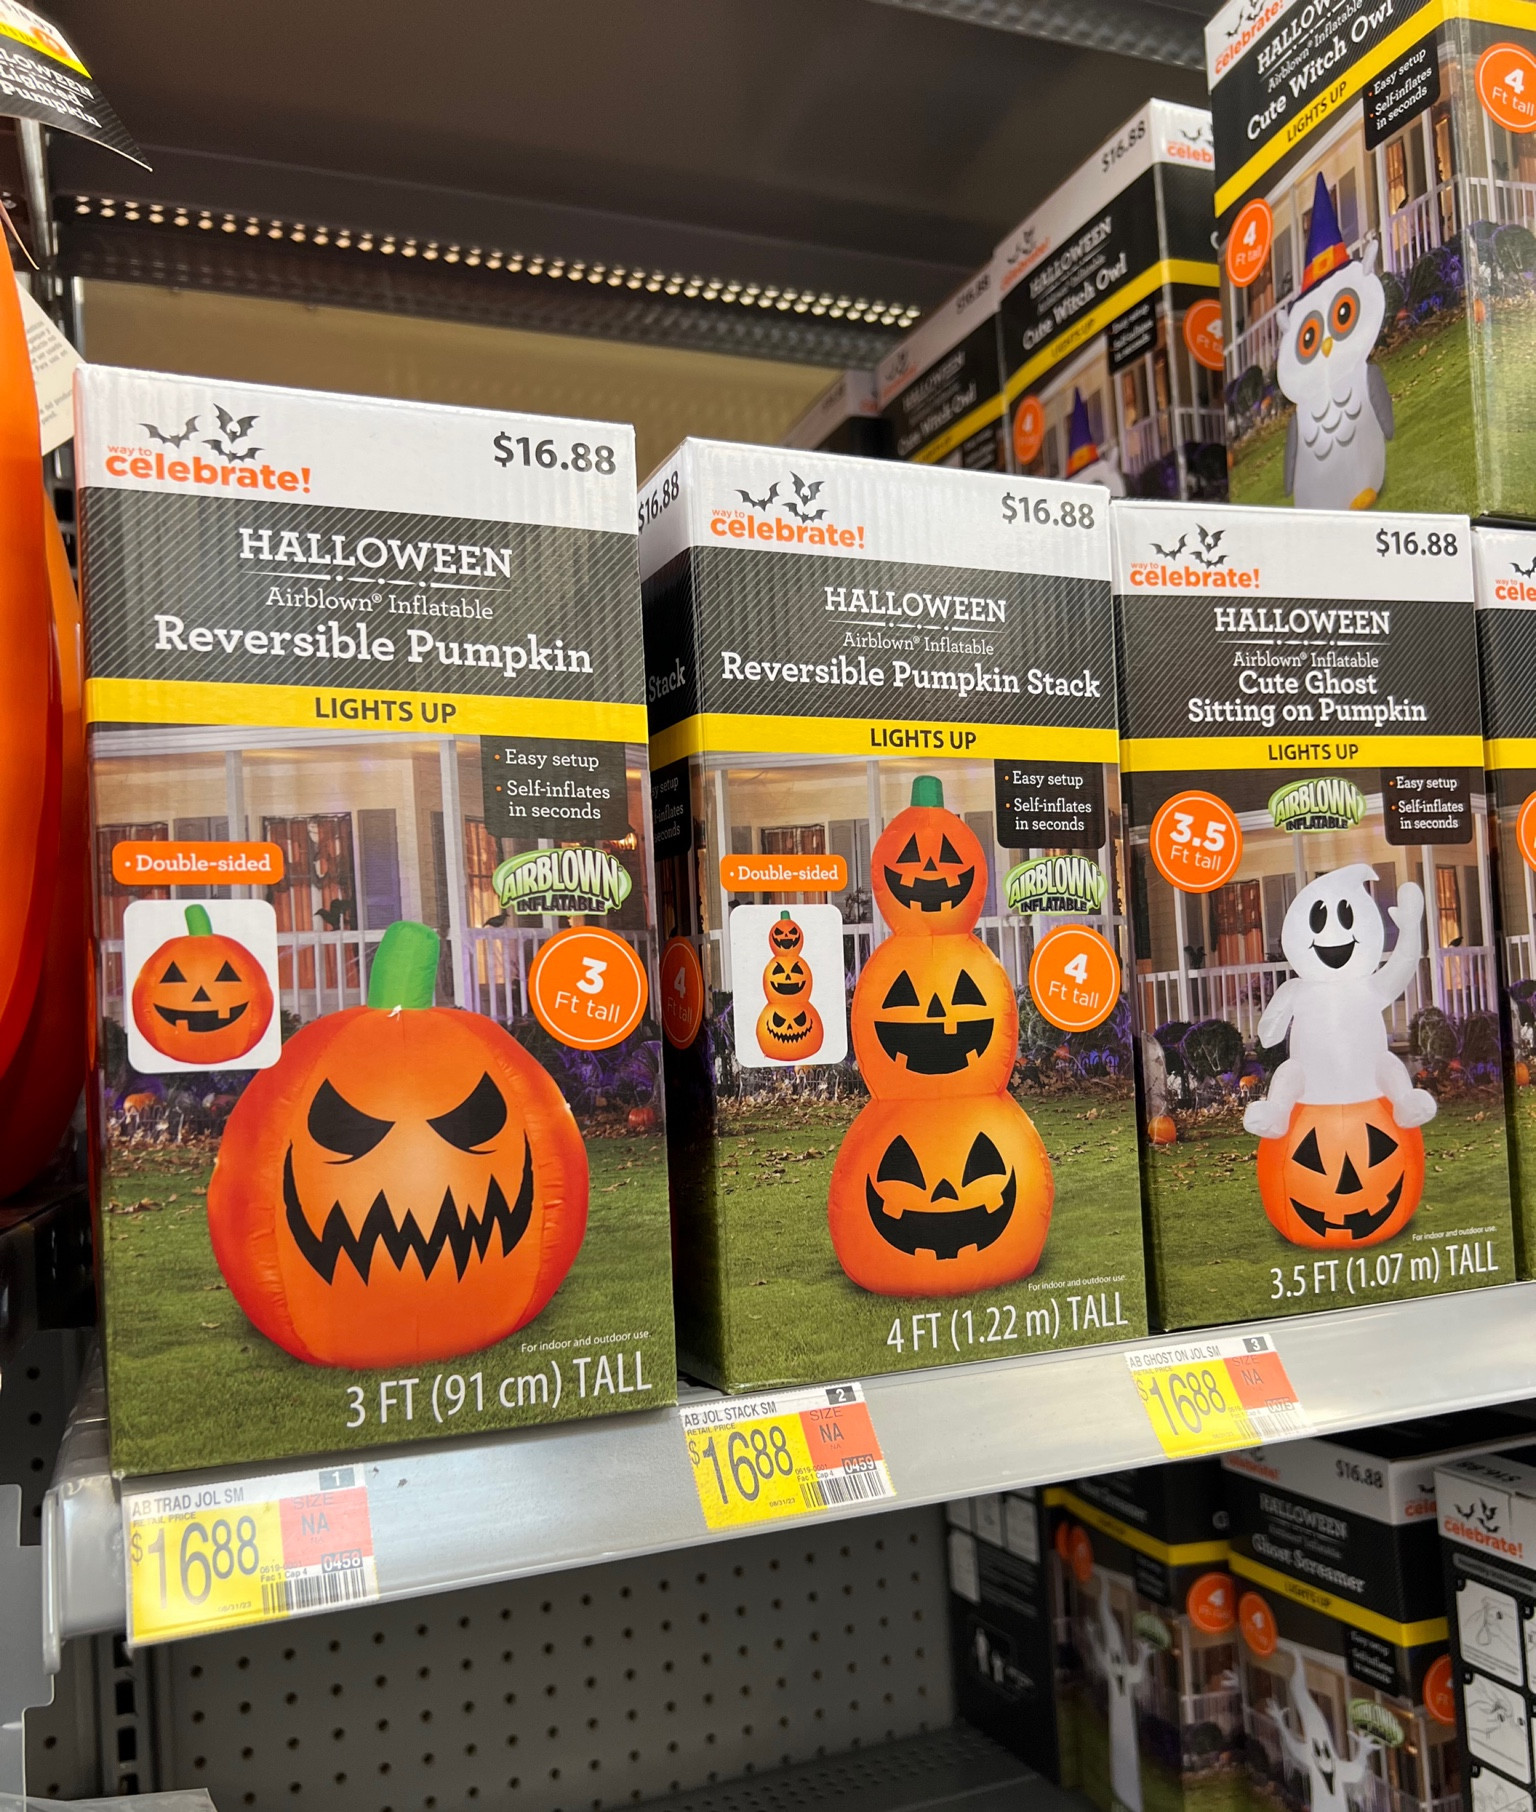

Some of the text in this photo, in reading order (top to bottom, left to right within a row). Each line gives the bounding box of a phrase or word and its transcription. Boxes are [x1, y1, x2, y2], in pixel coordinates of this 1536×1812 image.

[1247, 0, 1394, 140] Cute Witch Owl
[1373, 49, 1427, 95] Easy setup
[1504, 68, 1524, 94] 4
[1375, 67, 1432, 116] Self-inflates
[1492, 86, 1534, 116] Ft tall
[1287, 81, 1347, 142] LIGHTS UP
[1376, 86, 1427, 130] in seconds
[1243, 221, 1256, 247] 4
[1095, 251, 1129, 291] Owl
[107, 444, 152, 457] way to
[493, 431, 617, 476] $16.88
[105, 453, 311, 494] celebrate!
[638, 470, 680, 534] $16.88
[712, 509, 746, 519] way to
[1001, 492, 1095, 530] $16.88
[710, 515, 865, 549] celebrate!
[1375, 529, 1458, 557] $16.88
[239, 528, 513, 581] HALLOWEEN
[1130, 566, 1261, 589] celebrate!
[388, 594, 495, 621] Inflatable
[824, 586, 1006, 623] HALLOWEEN
[1214, 606, 1391, 635] HALLOWEEN
[154, 614, 594, 677] Reversible Pumpkin
[924, 636, 995, 656] Inflatable
[1310, 652, 1379, 668] Inflatable
[648, 657, 686, 702] Stack
[721, 651, 1101, 699] Reversible Pumpkin Stack
[1238, 670, 1377, 696] Cute Ghost
[315, 697, 458, 725] LIGHTS UP
[1188, 697, 1427, 729] Sitting on Pumpkin
[870, 727, 977, 750] LIGHTS UP
[505, 749, 599, 772] Easy setup
[1268, 744, 1359, 761] LIGHTS UP
[507, 779, 611, 799] Self-inflates
[1012, 770, 1083, 789] Easy setup
[1395, 776, 1458, 791] Easy setup
[508, 801, 601, 819] in seconds
[1014, 797, 1092, 813] Self-inflates
[1397, 799, 1464, 814] Self-inflates
[1015, 816, 1085, 831] in seconds
[1169, 812, 1226, 852] 3.5
[1285, 815, 1349, 831] INFLATABLE
[1400, 816, 1459, 830] in seconds
[136, 853, 272, 873] Double-sided
[1170, 847, 1222, 872] Ft tall
[737, 865, 839, 881] Double-sided
[516, 893, 606, 912] INFLATABLE
[1020, 896, 1088, 912] INFLATABLE
[576, 956, 608, 995] 3
[1063, 952, 1088, 984] 4
[673, 966, 687, 998] 4
[554, 990, 621, 1024] Ft tall
[1049, 981, 1099, 1009] Ft tall
[1424, 1226, 1483, 1240] indoor outdoor
[1270, 1240, 1499, 1299] 3.5 FT (1.07 m) TALL
[1028, 1276, 1111, 1292] For indoor and outdoor
[887, 1291, 1128, 1352] 4 FT (1.22 m) TALL
[521, 1332, 631, 1353] For indoor and outdoor
[1251, 1337, 1260, 1351] 3
[1129, 1345, 1221, 1368] AB GHOST ON JOL SM
[1231, 1356, 1260, 1366] SIZE
[346, 1350, 652, 1428] 3 FT (91 cm) TALL
[1241, 1368, 1264, 1386] NA
[835, 1388, 846, 1402] 2
[684, 1401, 777, 1427] AB JOL STACK SM
[810, 1406, 844, 1421] SIZE
[687, 1423, 736, 1436] RETAIL PRICE
[819, 1423, 845, 1443] NA
[844, 1456, 875, 1474] 0459
[1335, 1458, 1384, 1489] $16.88
[132, 1486, 244, 1517] AB TRAD JOL SM
[293, 1492, 333, 1509] SIZE
[168, 1511, 196, 1522] PRICE
[301, 1511, 330, 1535] NA
[1444, 1517, 1525, 1559] celebrate!
[322, 1554, 362, 1572] 0458
